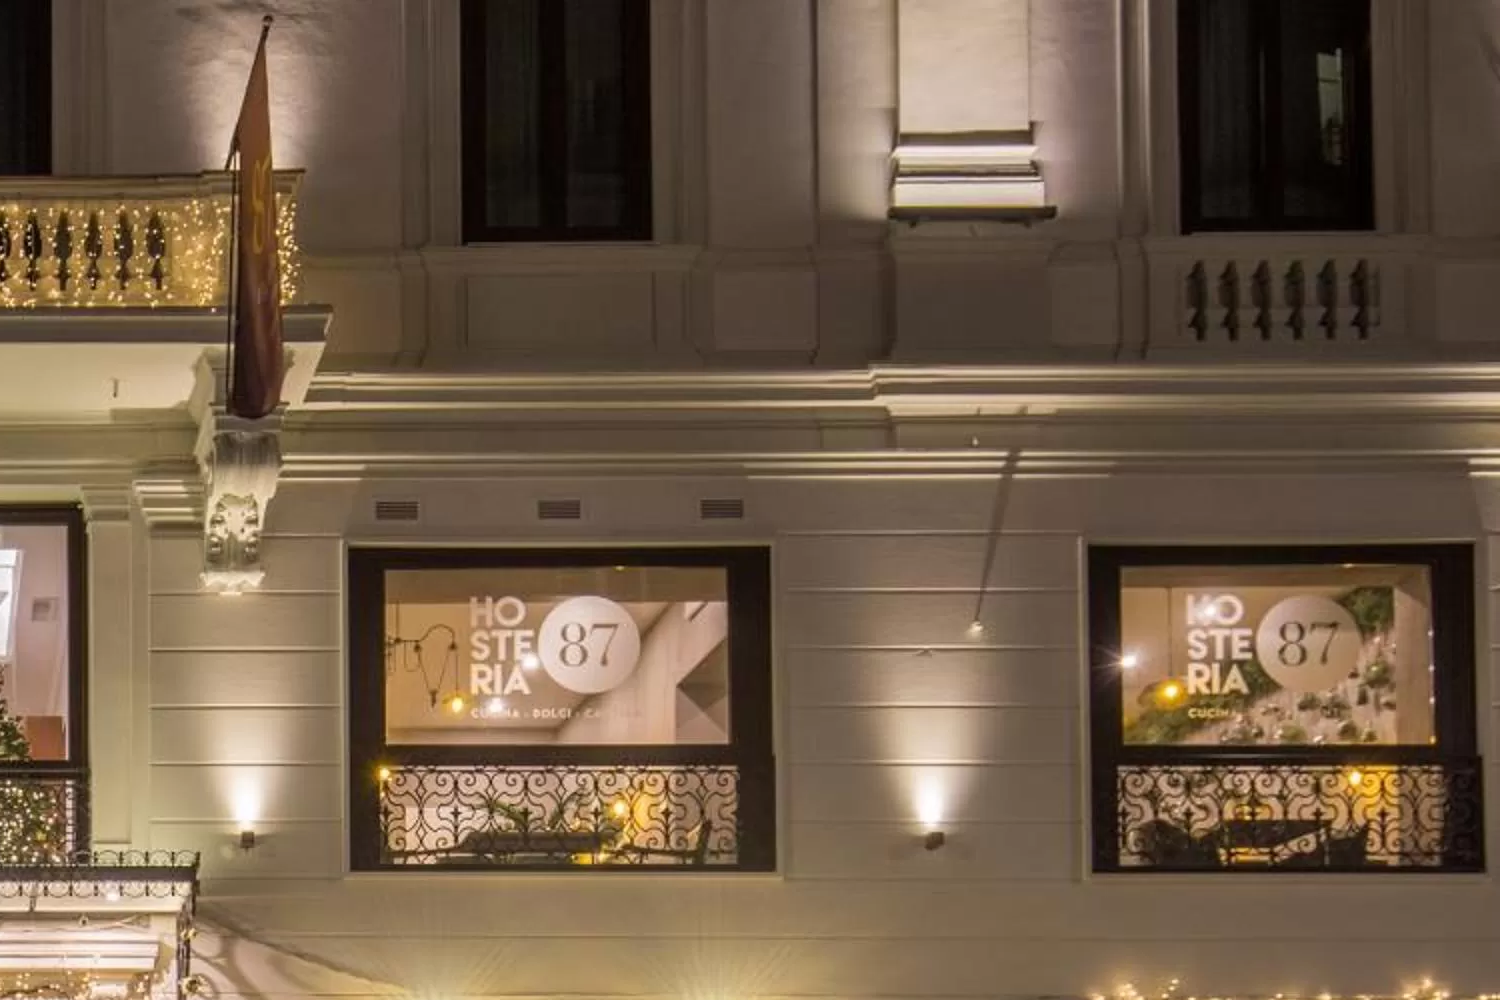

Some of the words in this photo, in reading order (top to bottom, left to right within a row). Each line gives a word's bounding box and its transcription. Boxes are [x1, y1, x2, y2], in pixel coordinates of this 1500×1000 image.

[469, 595, 526, 627] HO
[470, 629, 535, 662] STE
[559, 622, 620, 667] 87
[1187, 627, 1253, 660] STE
[1278, 621, 1341, 667] 87
[470, 663, 532, 695] RIA
[1187, 662, 1249, 695] RIA
